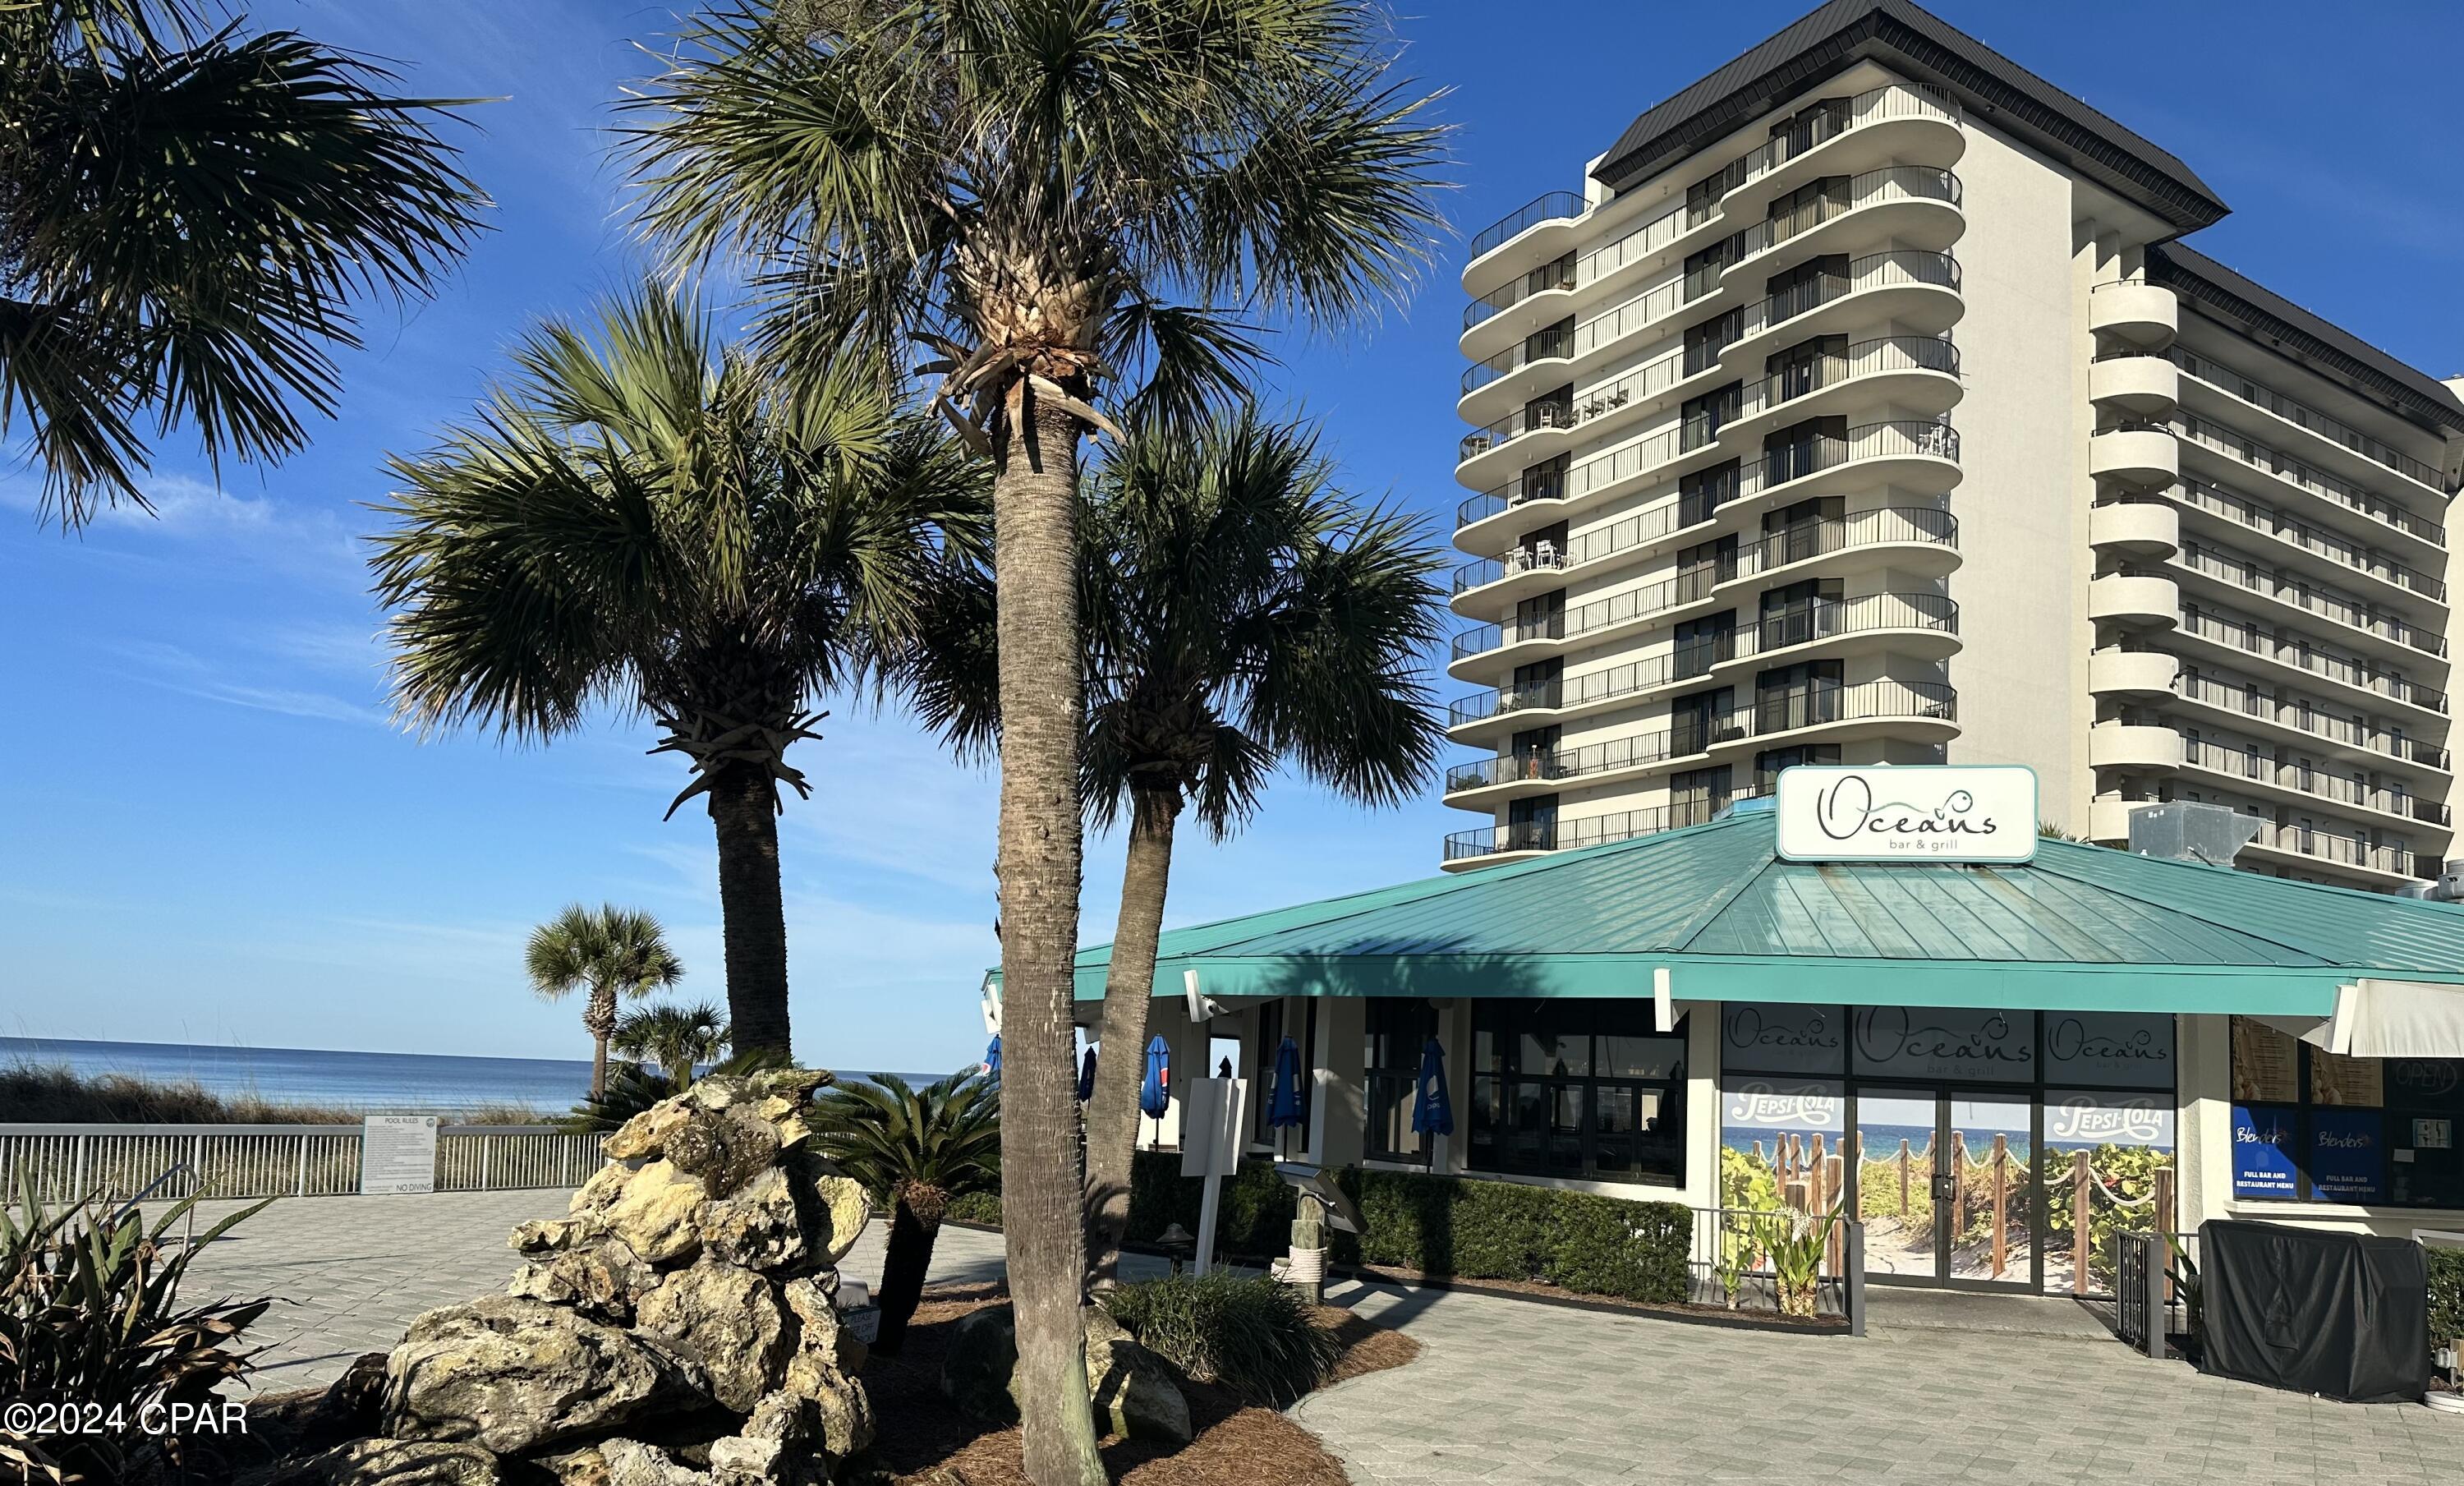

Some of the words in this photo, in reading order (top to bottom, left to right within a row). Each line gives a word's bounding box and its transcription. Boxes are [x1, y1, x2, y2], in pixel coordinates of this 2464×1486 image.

[1817, 775, 1997, 840] Oceans
[1889, 839, 1910, 850] bar
[1916, 839, 1926, 850] &
[1931, 839, 1958, 853] grill
[1728, 1007, 1839, 1048] Oceans
[1855, 1005, 2032, 1064] Oceans
[2048, 1018, 2167, 1060] Oceans
[1927, 1064, 1948, 1074] bar
[1953, 1064, 1963, 1074] &
[1968, 1065, 1994, 1078] grill
[2396, 1061, 2447, 1088] OPEN
[2236, 1126, 2282, 1144] Blenders
[2319, 1130, 2364, 1149] Blenders
[409, 1183, 432, 1191] DIVING
[2236, 1180, 2276, 1189] RESTAURANT
[2318, 1184, 2358, 1192] RESTAURANT
